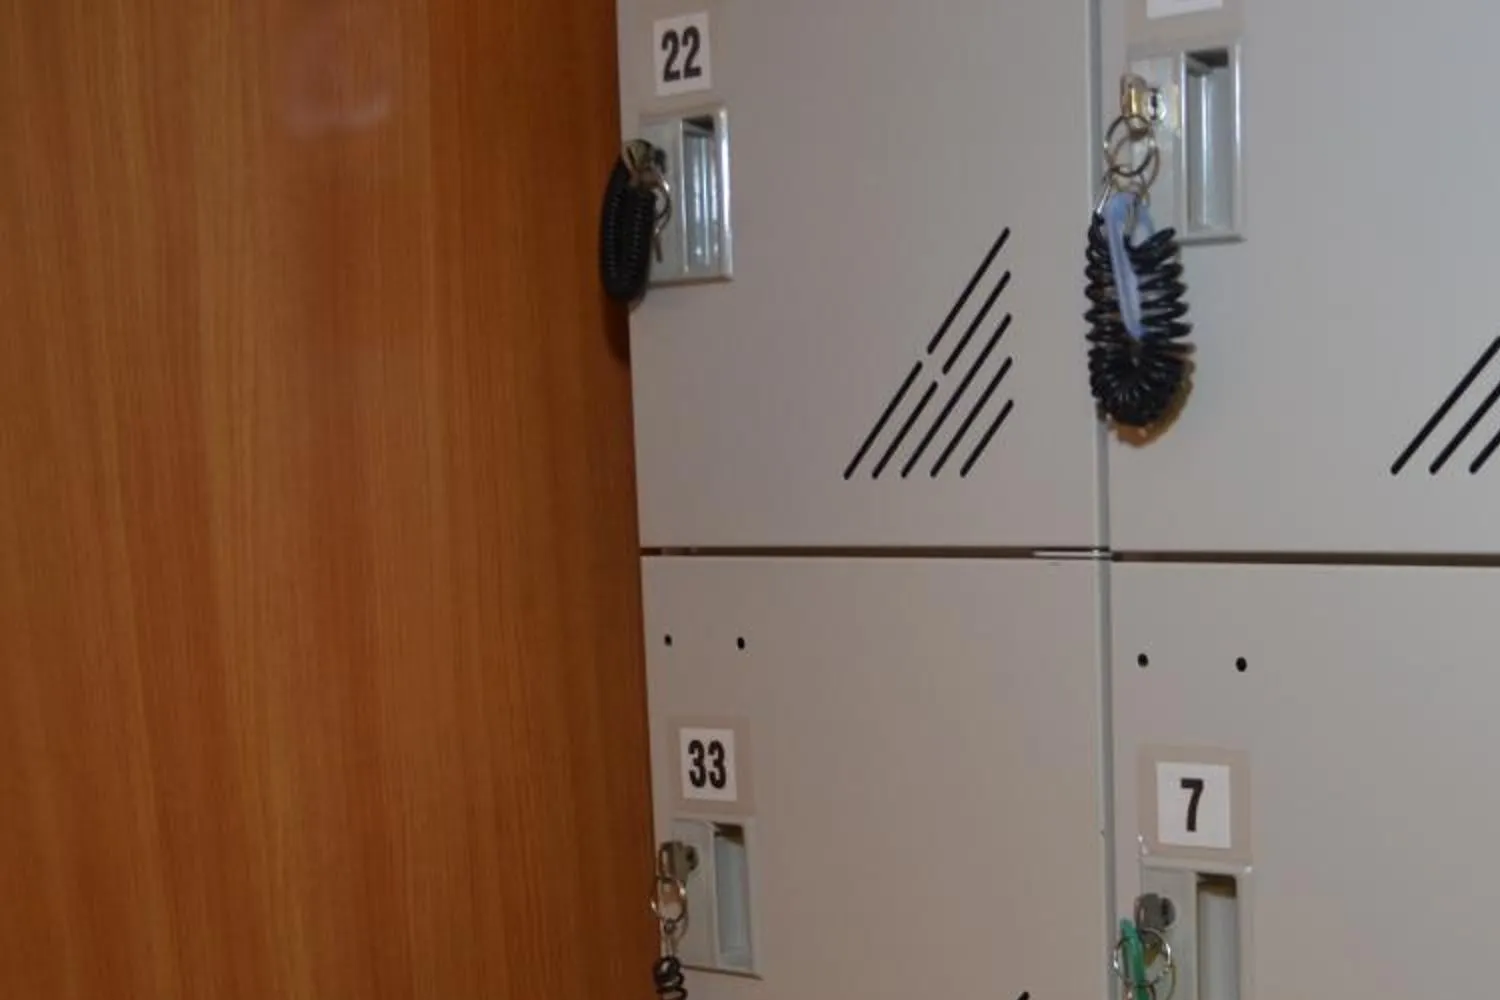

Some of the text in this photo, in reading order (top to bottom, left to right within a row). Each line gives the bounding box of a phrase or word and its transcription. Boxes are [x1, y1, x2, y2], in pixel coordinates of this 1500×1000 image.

[661, 26, 702, 83] 22
[687, 739, 727, 790] 33
[1178, 777, 1205, 834] 7
